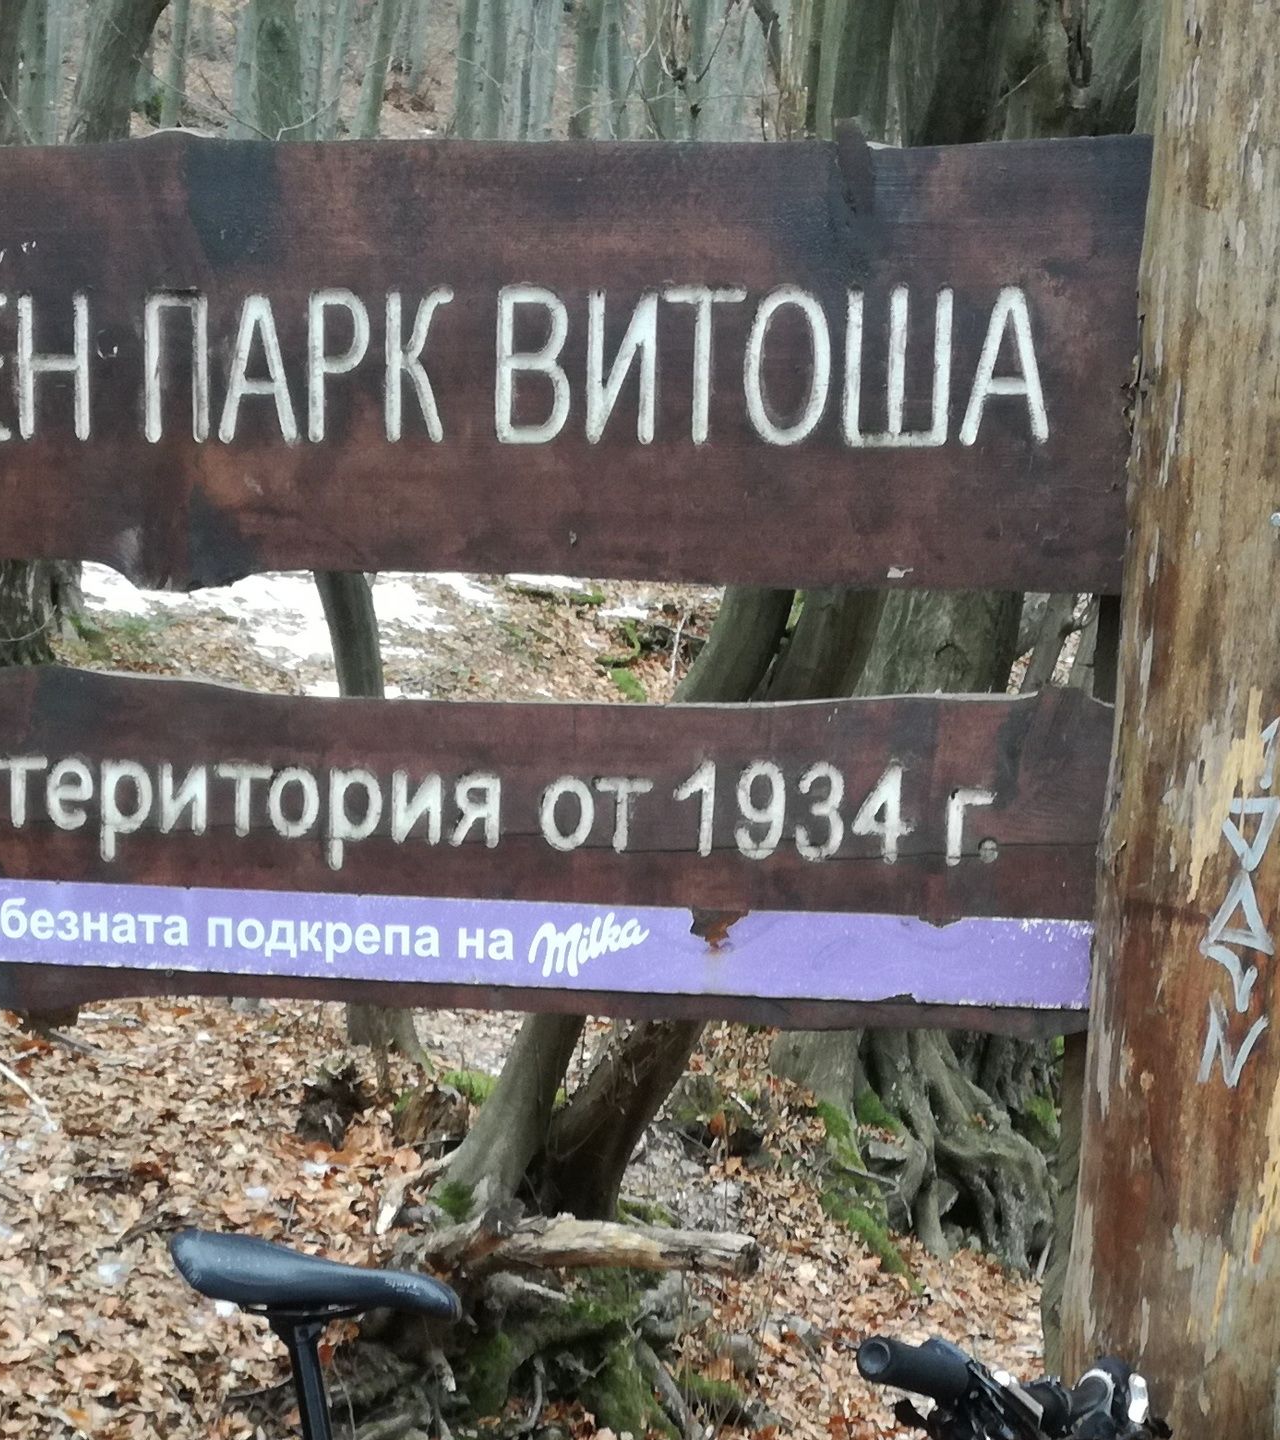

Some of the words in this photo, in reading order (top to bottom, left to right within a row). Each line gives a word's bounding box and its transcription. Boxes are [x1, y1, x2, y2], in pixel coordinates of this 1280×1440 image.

[144, 287, 454, 444] ПАРК
[495, 282, 1049, 448] ВИТОША
[539, 774, 653, 854] от
[674, 758, 914, 863] 1934
[946, 786, 1000, 867] г.
[207, 914, 440, 963] подкрепа
[457, 926, 515, 961] на
[528, 911, 651, 978] Milka
